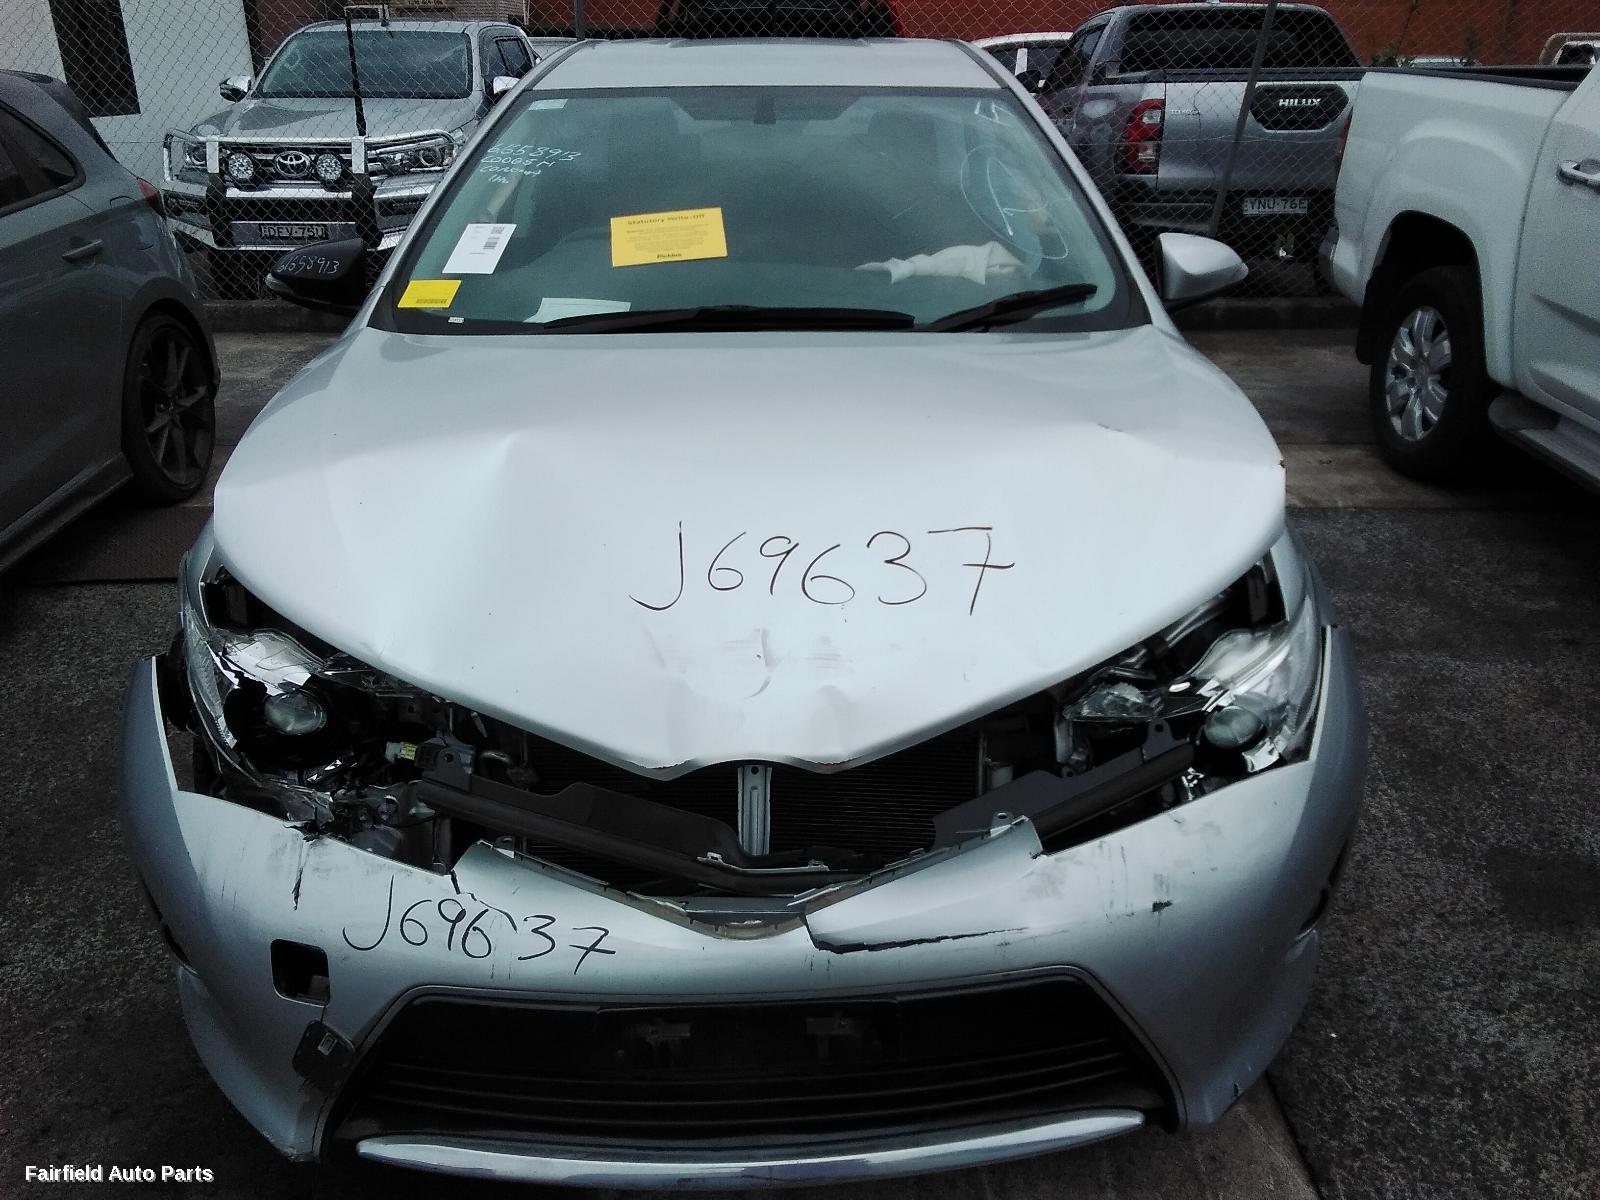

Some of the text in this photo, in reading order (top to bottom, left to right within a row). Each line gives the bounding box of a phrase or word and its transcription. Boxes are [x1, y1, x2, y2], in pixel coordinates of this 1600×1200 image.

[1278, 98, 1322, 107] HILUX
[628, 520, 1015, 616] J69637
[342, 874, 617, 976] J69637
